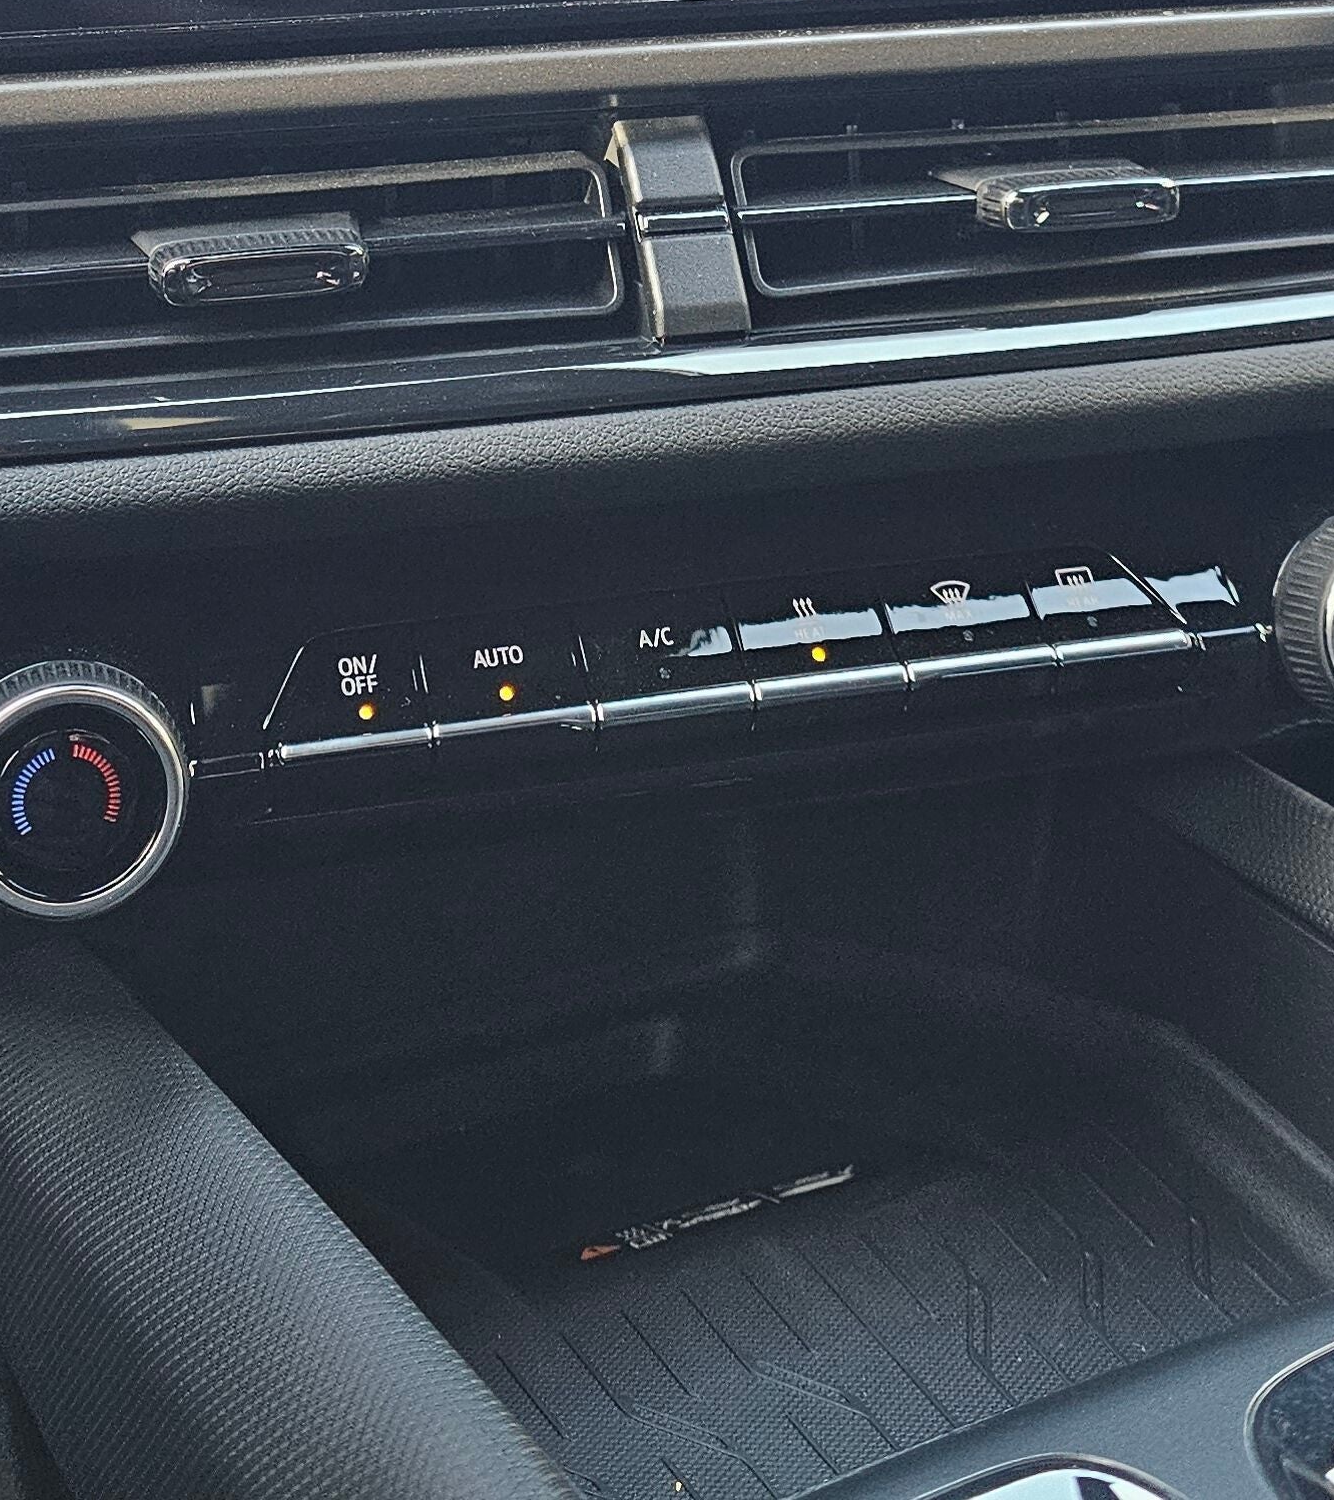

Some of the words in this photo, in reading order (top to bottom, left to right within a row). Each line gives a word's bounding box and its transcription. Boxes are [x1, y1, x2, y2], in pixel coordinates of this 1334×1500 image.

[638, 626, 675, 649] A/C
[337, 653, 377, 678] ON/
[473, 644, 524, 670] AUTO
[340, 673, 378, 697] OFF
